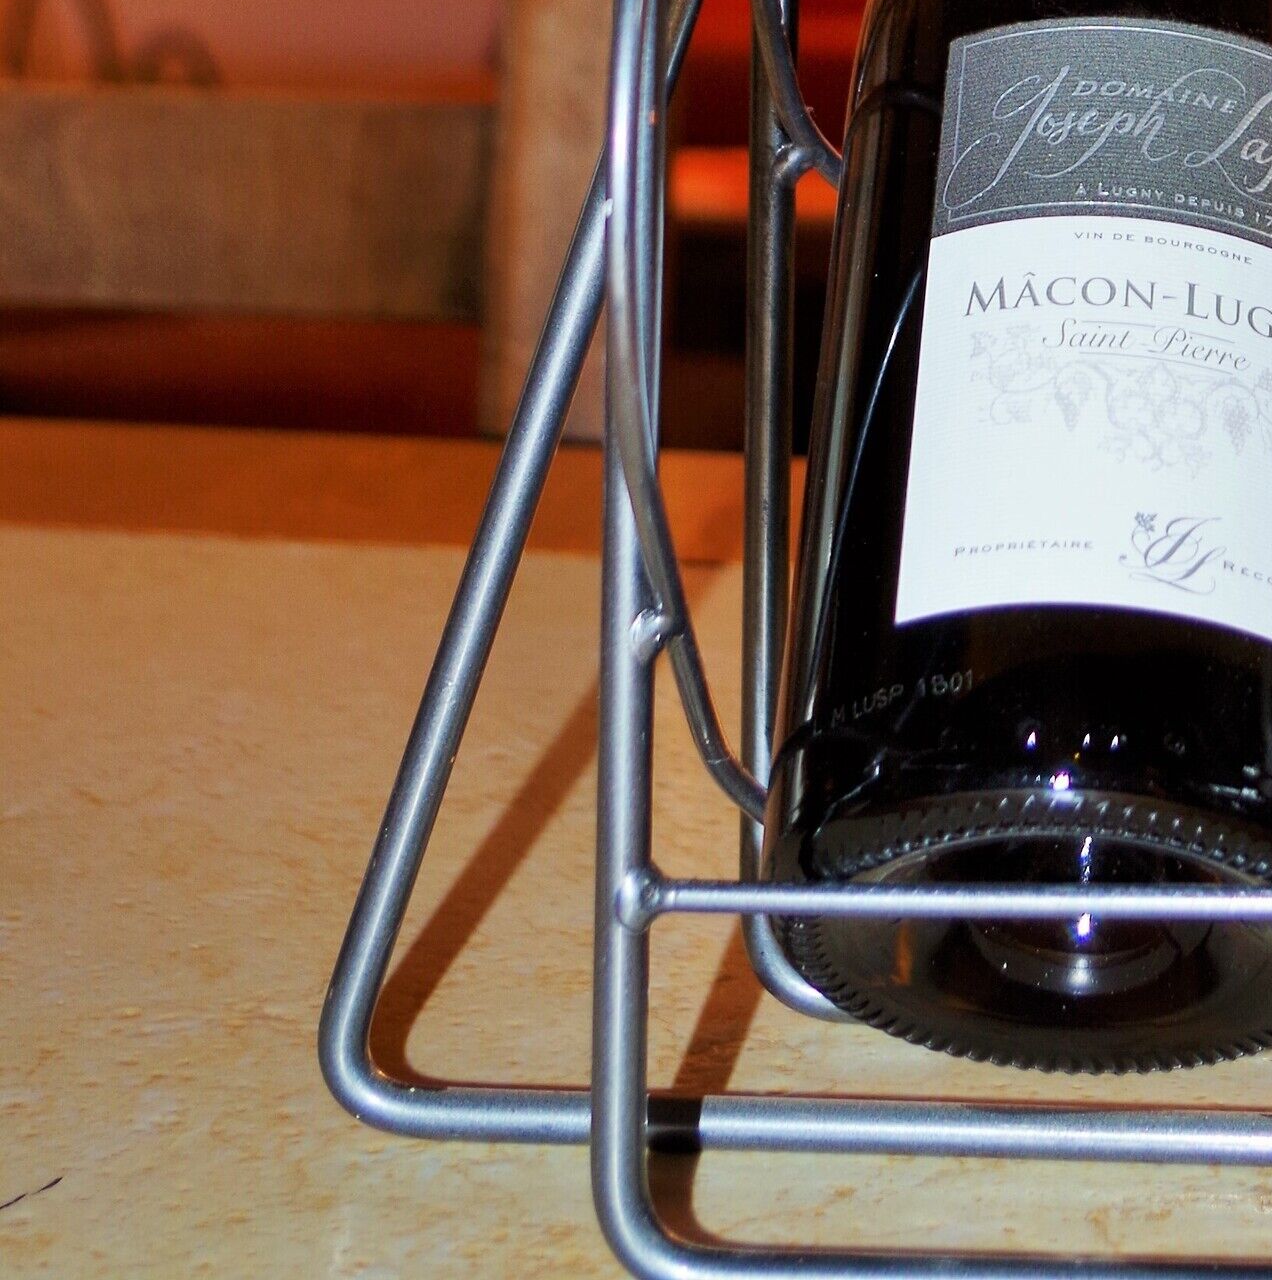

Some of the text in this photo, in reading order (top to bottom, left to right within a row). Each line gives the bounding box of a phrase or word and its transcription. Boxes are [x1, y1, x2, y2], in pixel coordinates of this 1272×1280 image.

[1072, 79, 1238, 114] DOMAINE
[942, 65, 1246, 208] Joseph
[1097, 182, 1164, 200] LUGNY
[1174, 193, 1245, 218] DEPUIS
[1074, 231, 1253, 265] VIN DE BOURGOGNE
[1042, 317, 1251, 371] Saint Pierre
